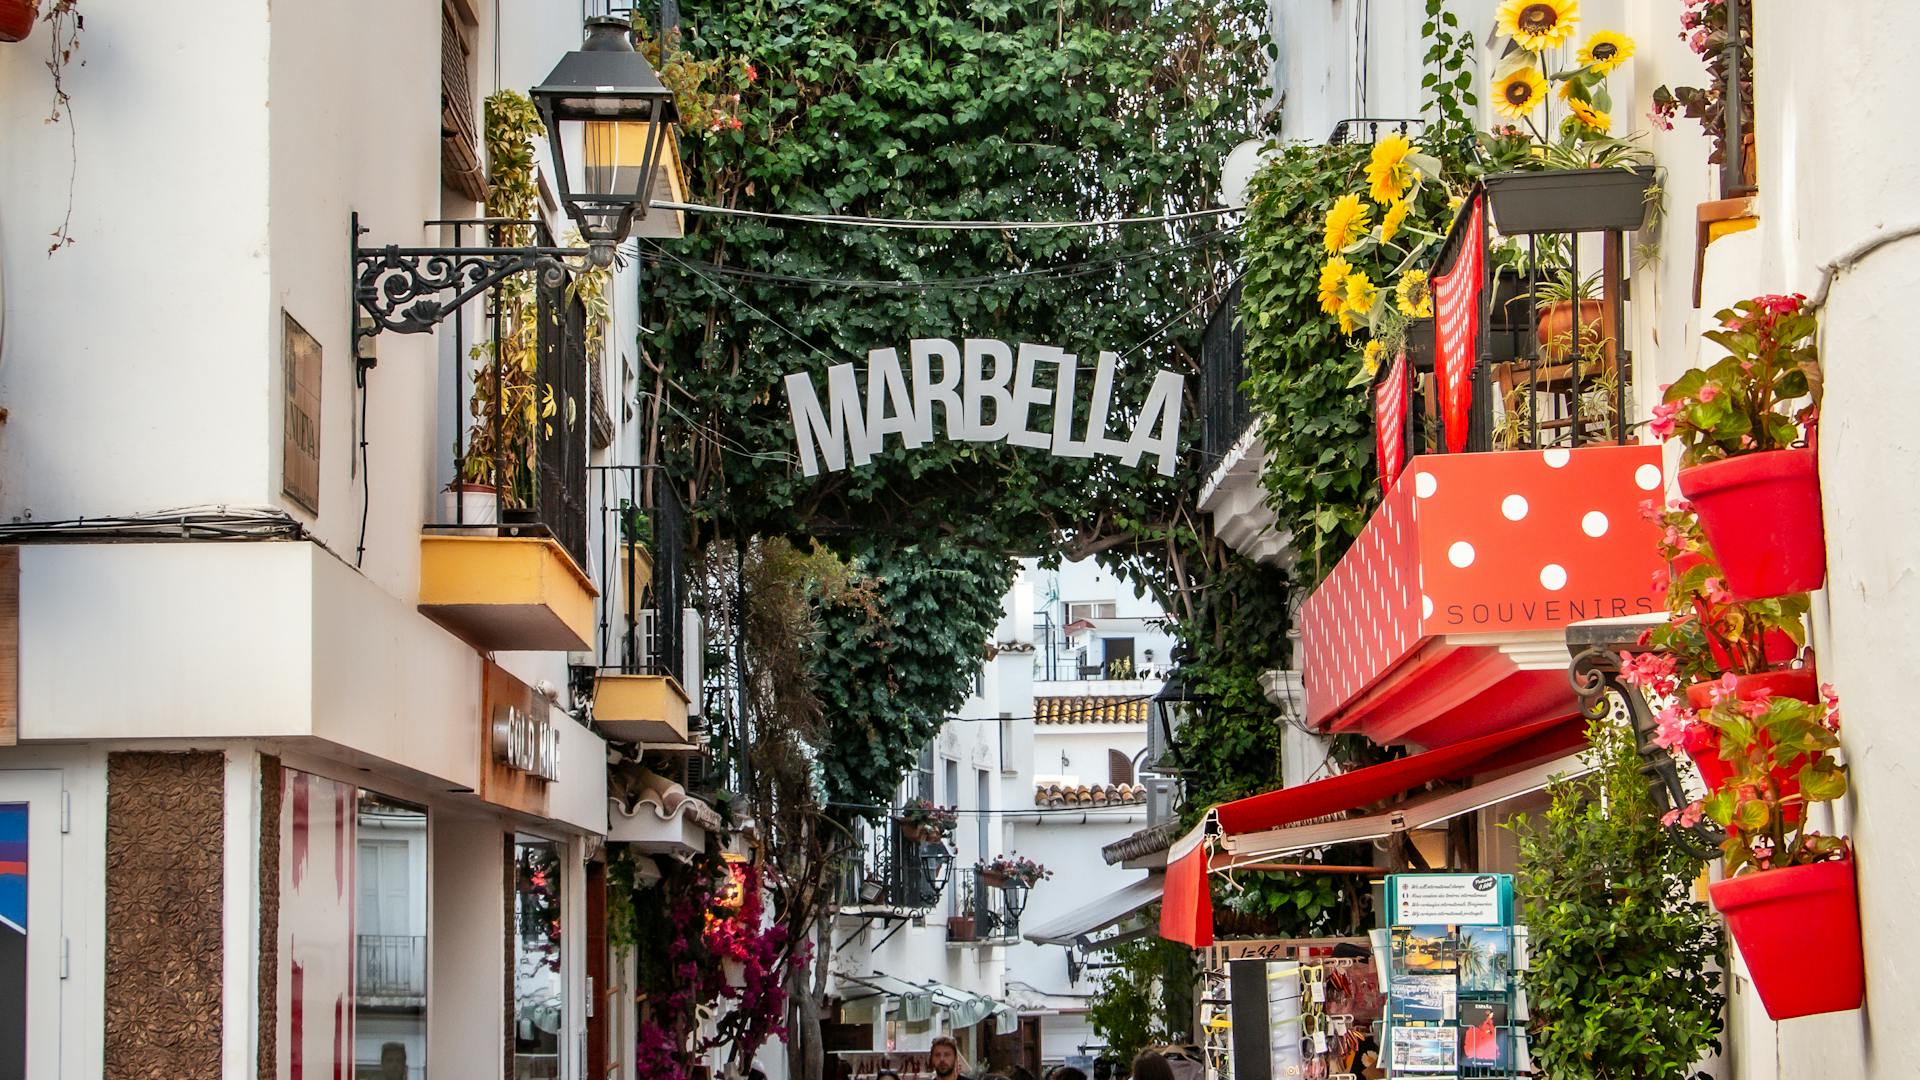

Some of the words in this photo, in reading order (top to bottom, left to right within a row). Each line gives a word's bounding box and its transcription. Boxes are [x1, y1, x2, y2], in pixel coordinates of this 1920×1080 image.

[784, 338, 1184, 477] MARBELLA
[1447, 597, 1653, 624] SOUVENIRS
[506, 705, 535, 771] GOLD
